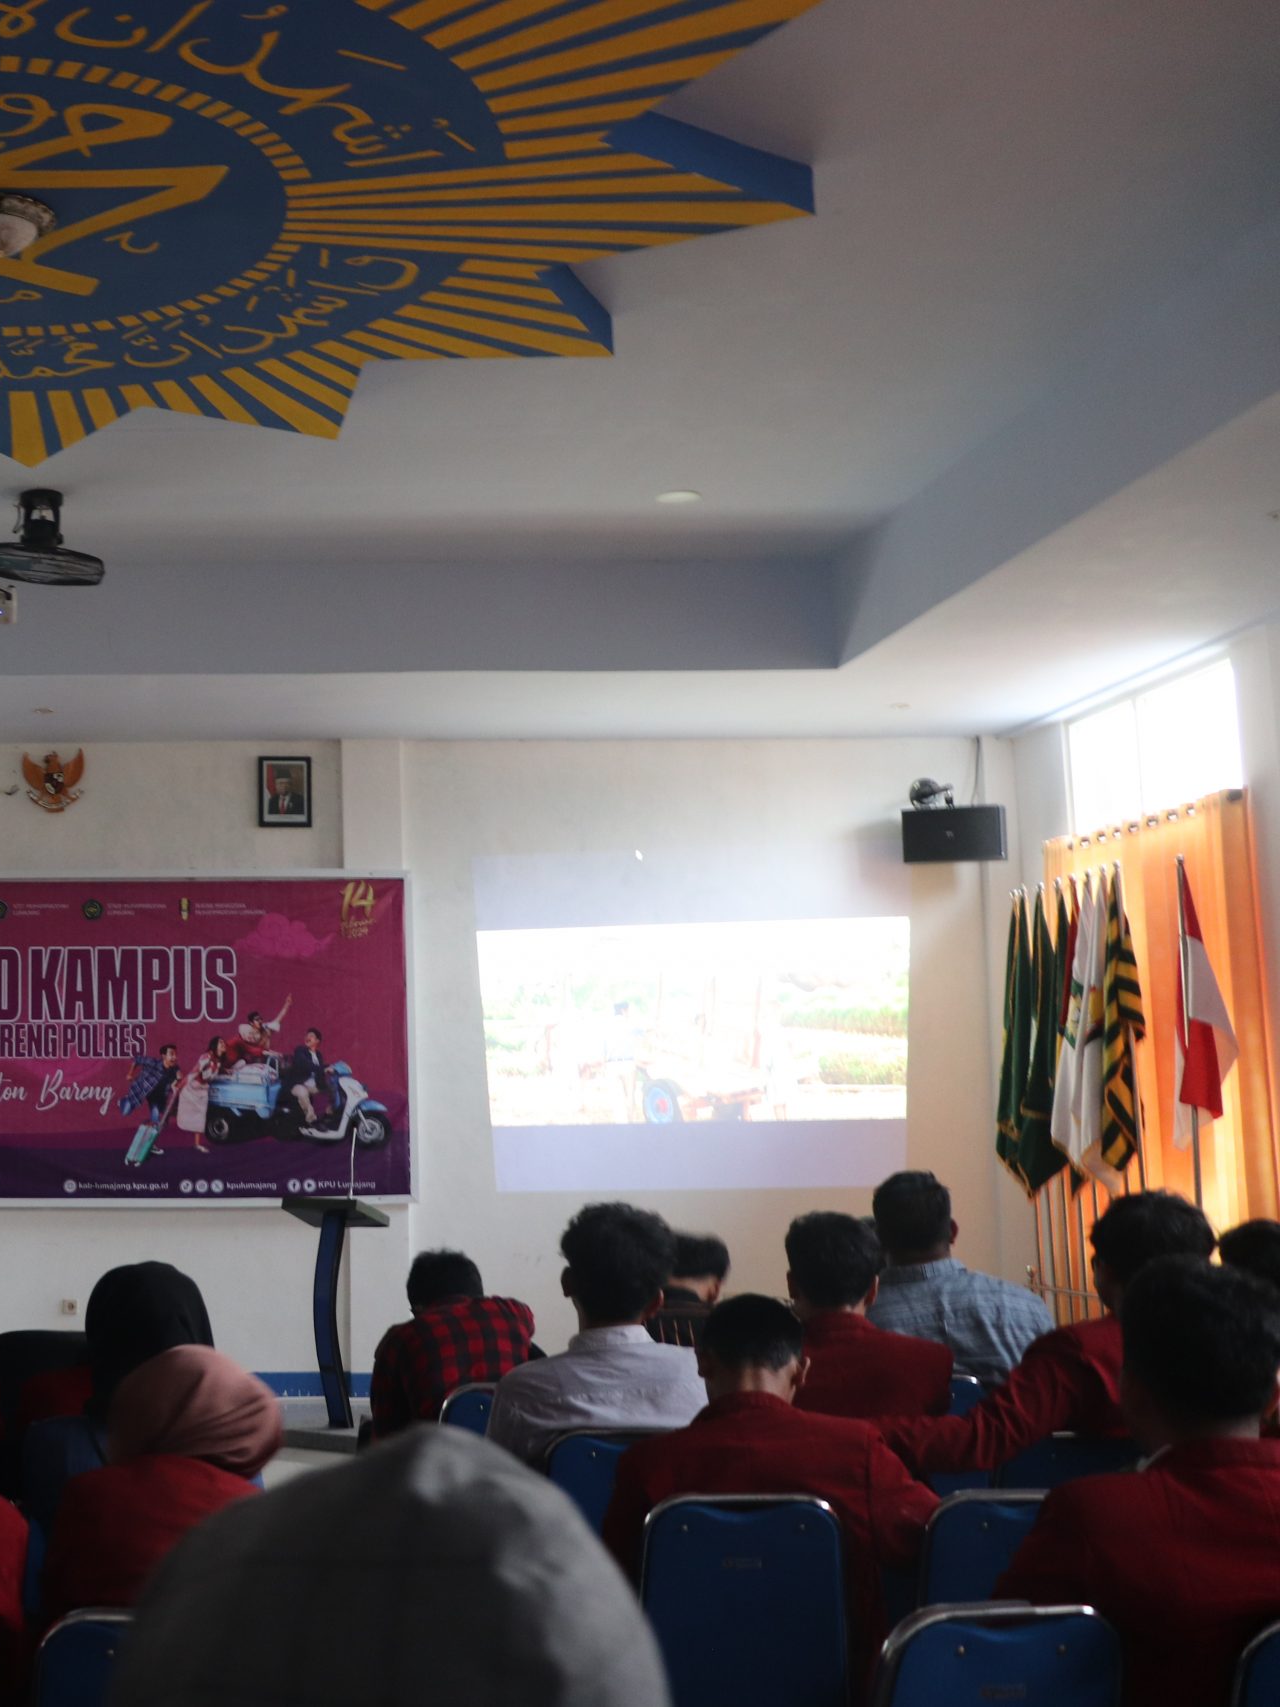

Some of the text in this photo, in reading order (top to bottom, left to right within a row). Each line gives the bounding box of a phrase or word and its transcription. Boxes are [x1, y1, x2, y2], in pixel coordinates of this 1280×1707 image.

[339, 880, 376, 921] 14
[27, 946, 238, 1023] KAMPUS
[60, 1021, 147, 1059] POLRES
[35, 1068, 115, 1116] Bareng
[226, 1180, 277, 1192] kpulumajang
[318, 1180, 336, 1189] KPU
